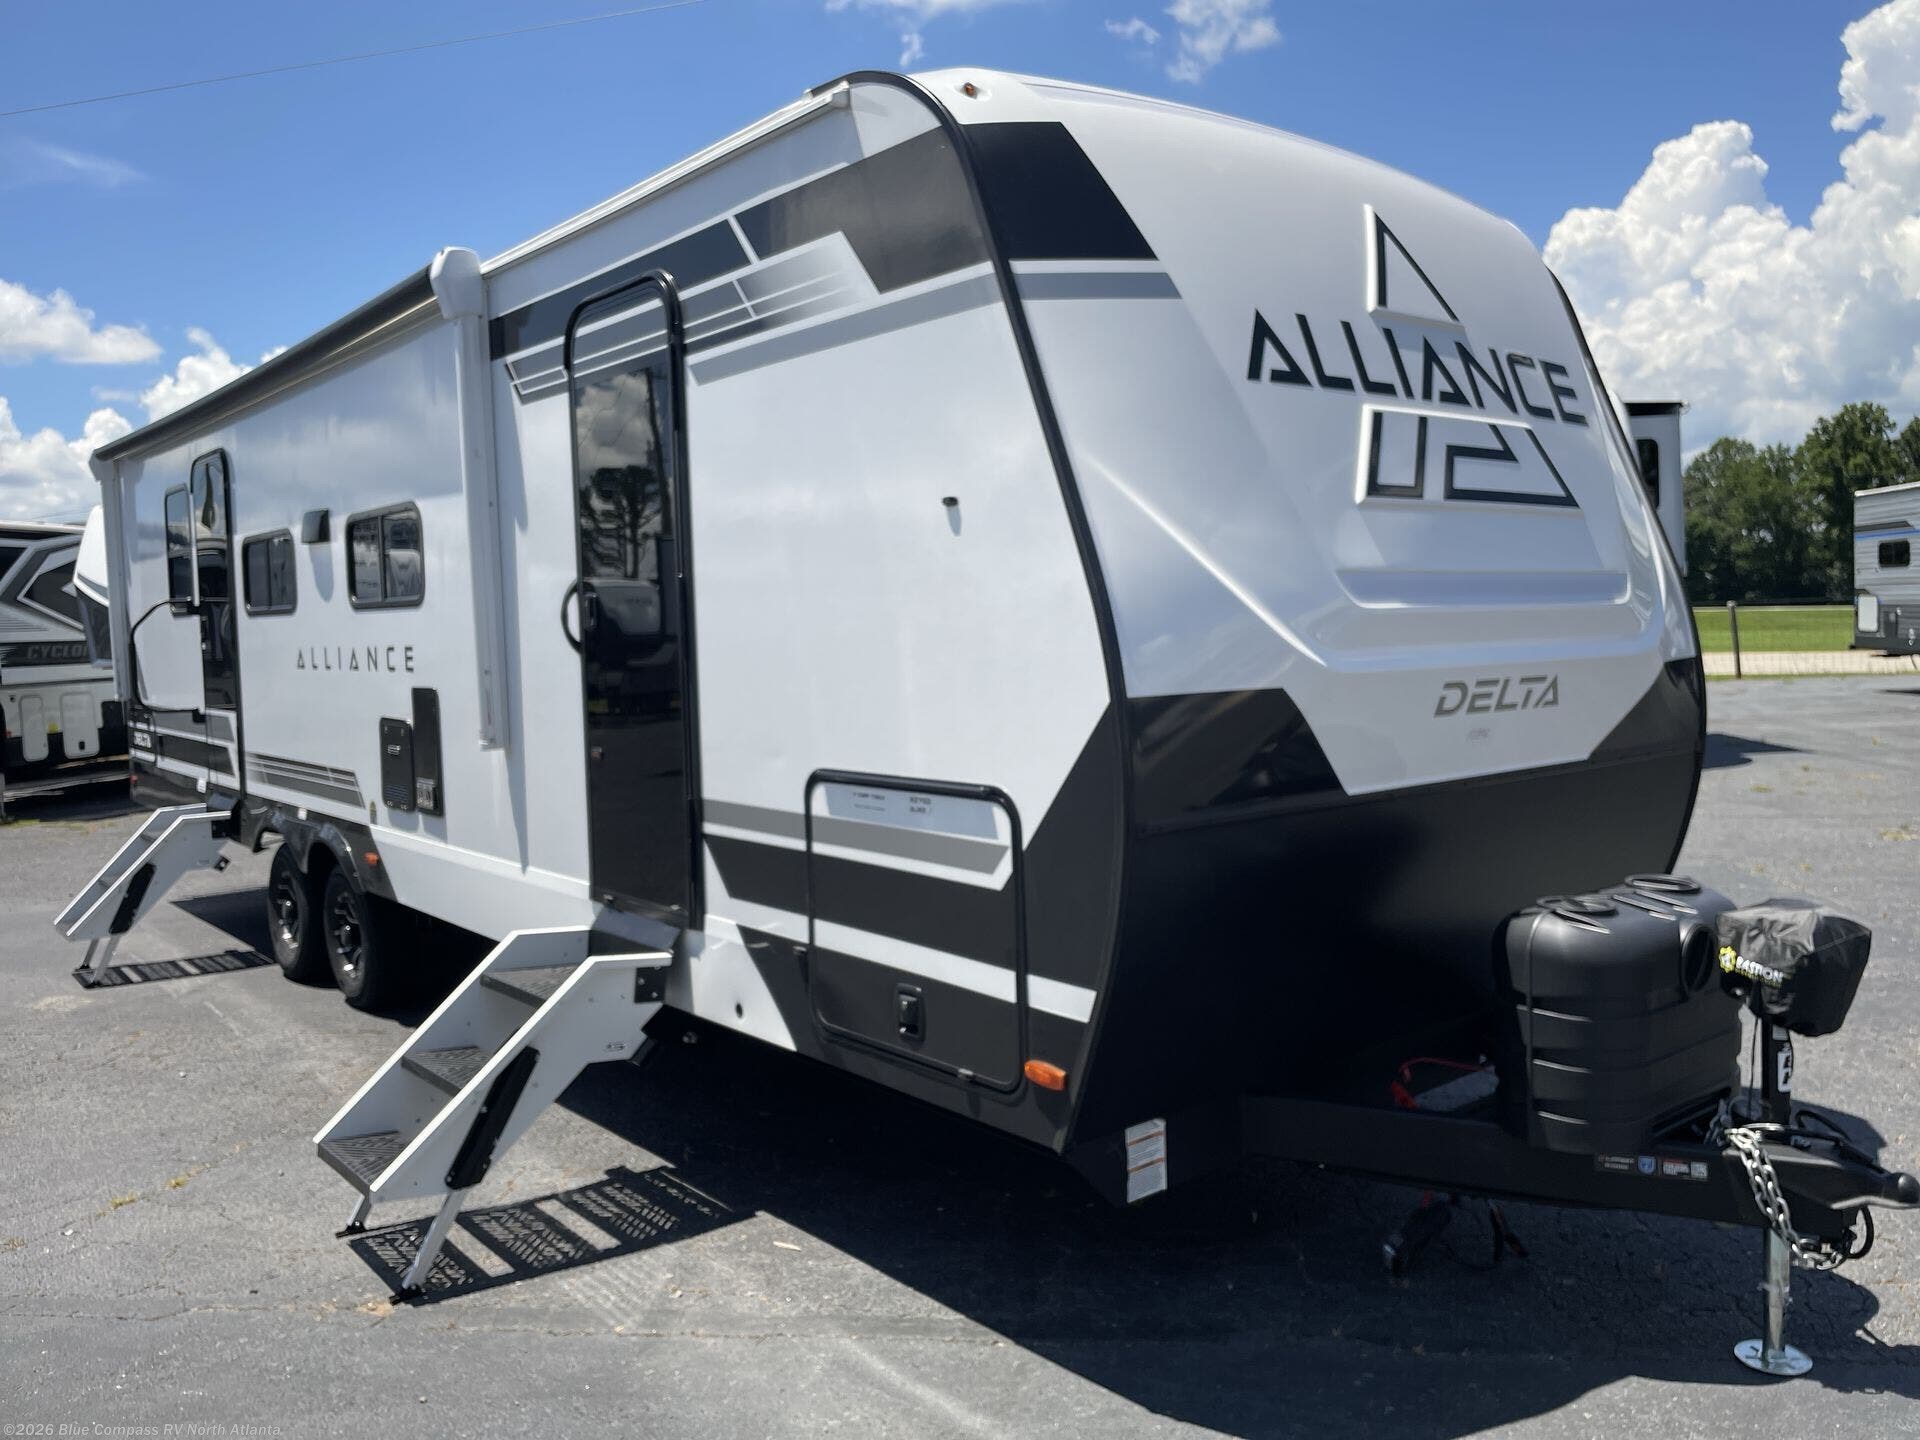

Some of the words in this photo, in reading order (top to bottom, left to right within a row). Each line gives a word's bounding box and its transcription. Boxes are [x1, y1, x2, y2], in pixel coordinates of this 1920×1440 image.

[1247, 308, 1588, 426] ALLIANCE
[296, 646, 415, 672] ALLIANCE
[1434, 674, 1560, 717] DELTA
